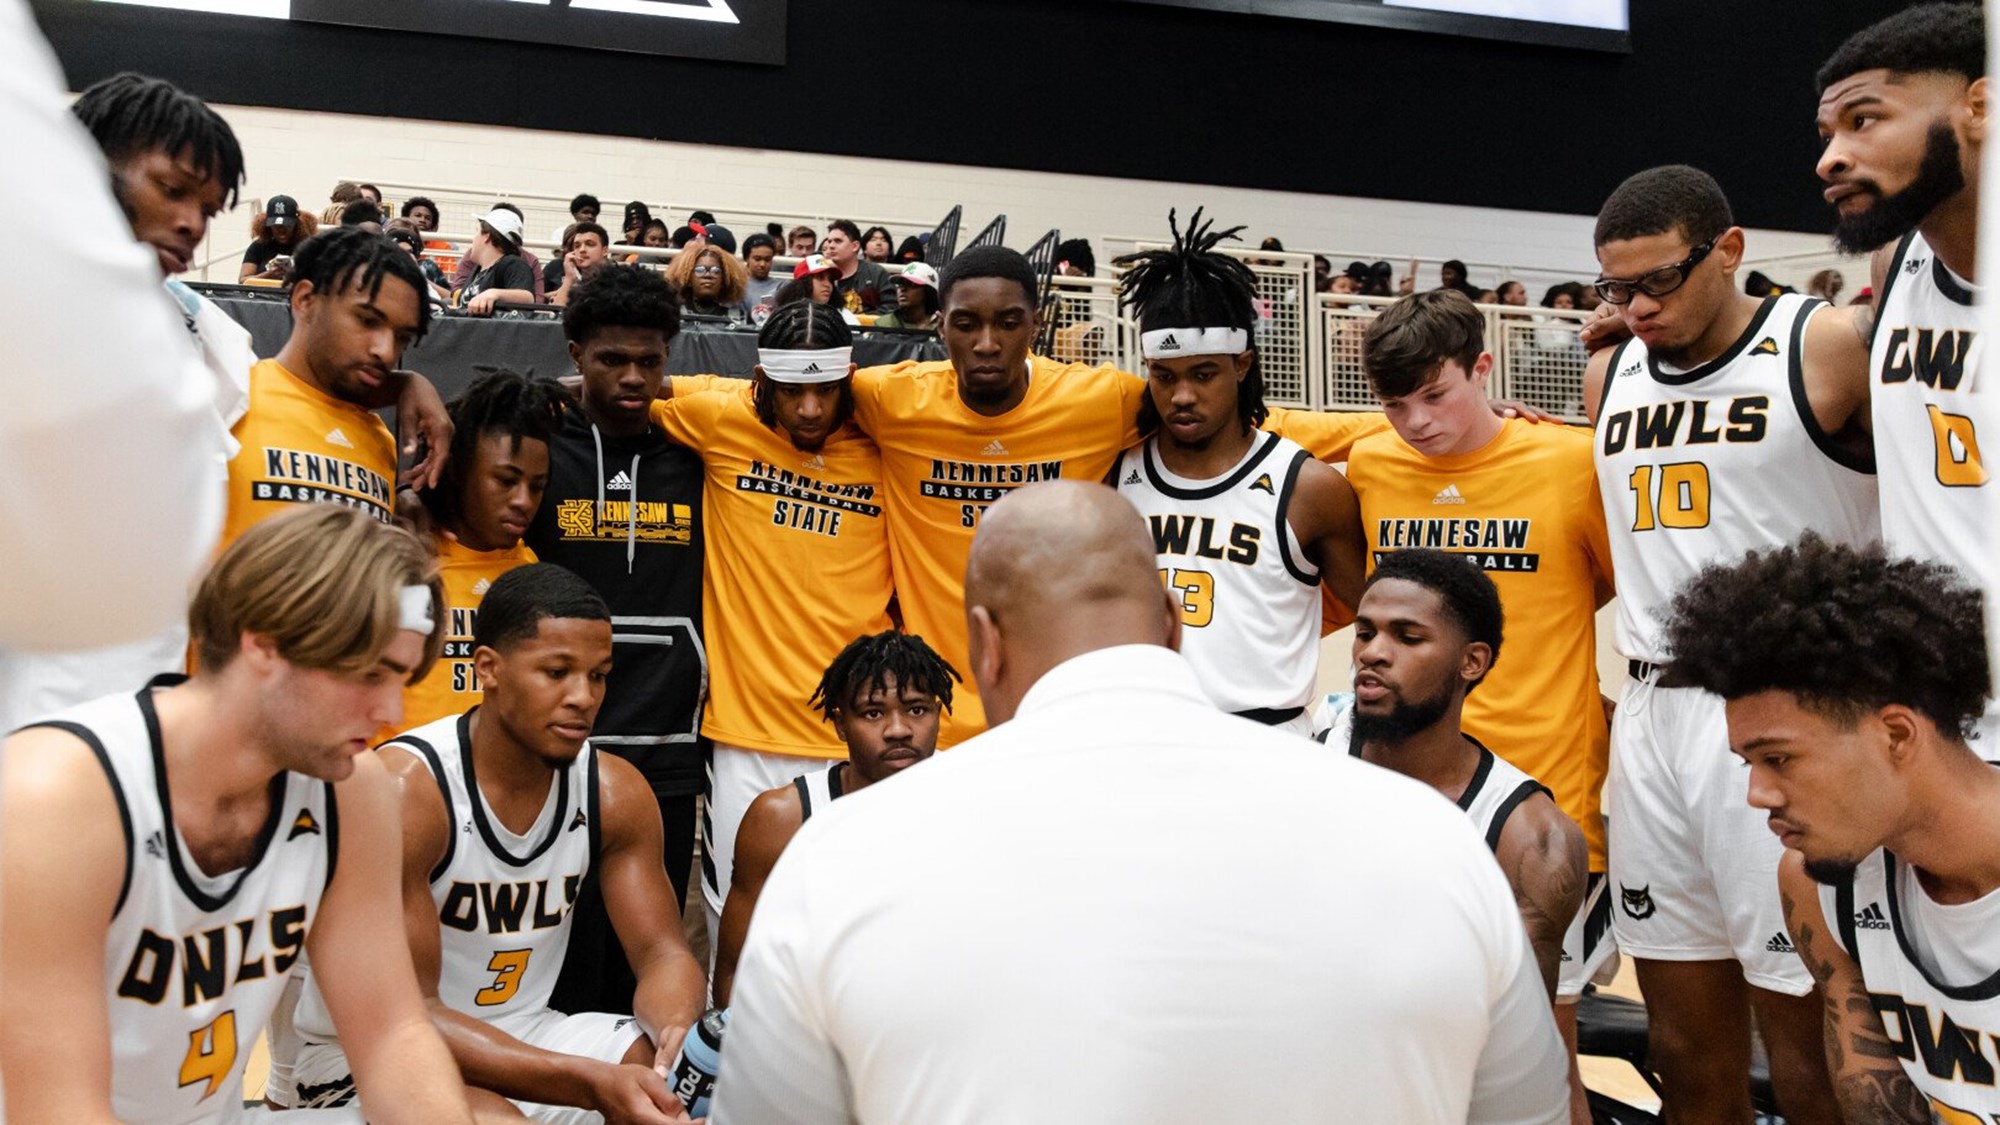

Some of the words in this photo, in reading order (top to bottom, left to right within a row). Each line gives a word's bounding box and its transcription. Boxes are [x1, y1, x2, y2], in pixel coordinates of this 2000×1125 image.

[1882, 326, 1978, 394] OW
[1603, 395, 1770, 457] OWLS
[1924, 402, 1990, 488] 0
[263, 447, 391, 507] KENNESAW
[606, 482, 632, 490] adida
[748, 459, 875, 501] KENNESAW
[924, 483, 1010, 500] BASKET
[930, 458, 1063, 483] KENNESAW
[256, 483, 393, 525] BASKETBAL
[739, 478, 877, 515] BASKETBALL
[773, 499, 841, 537] STATE
[1432, 495, 1466, 505] adidas
[1629, 460, 1712, 532] 10
[1148, 513, 1262, 567] WLS
[1377, 517, 1531, 550] KENNESAW
[474, 948, 533, 1007] 3
[178, 1009, 239, 1106] 4
[1868, 991, 2000, 1087] OW
